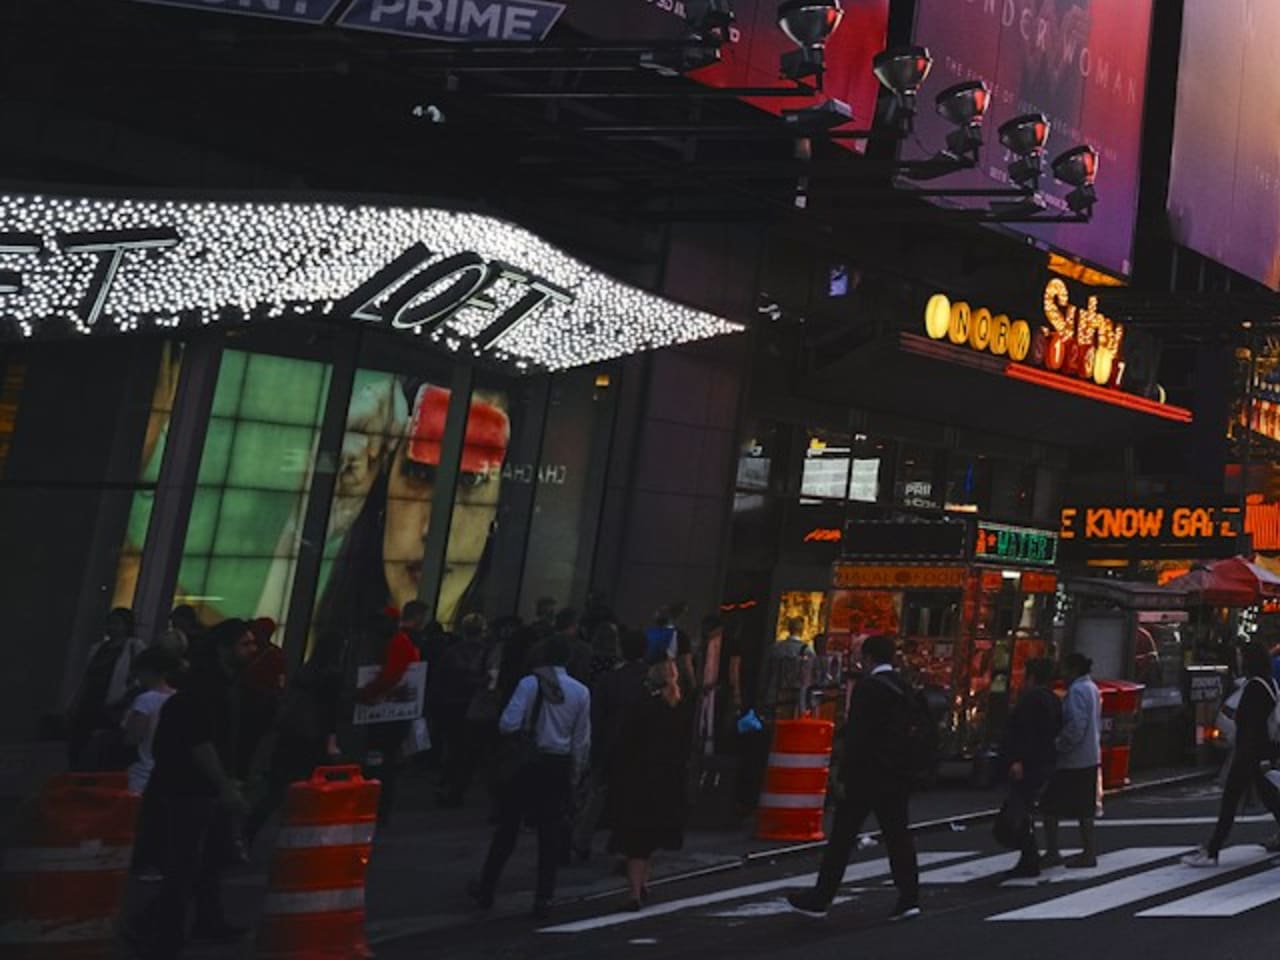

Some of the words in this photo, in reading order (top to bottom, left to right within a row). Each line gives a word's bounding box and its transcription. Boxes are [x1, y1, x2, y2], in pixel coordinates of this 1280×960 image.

[1063, 30, 1139, 106] WOMAN
[336, 240, 577, 353] LOFT
[1085, 505, 1164, 539] KNOW
[1171, 504, 1239, 539] GAE
